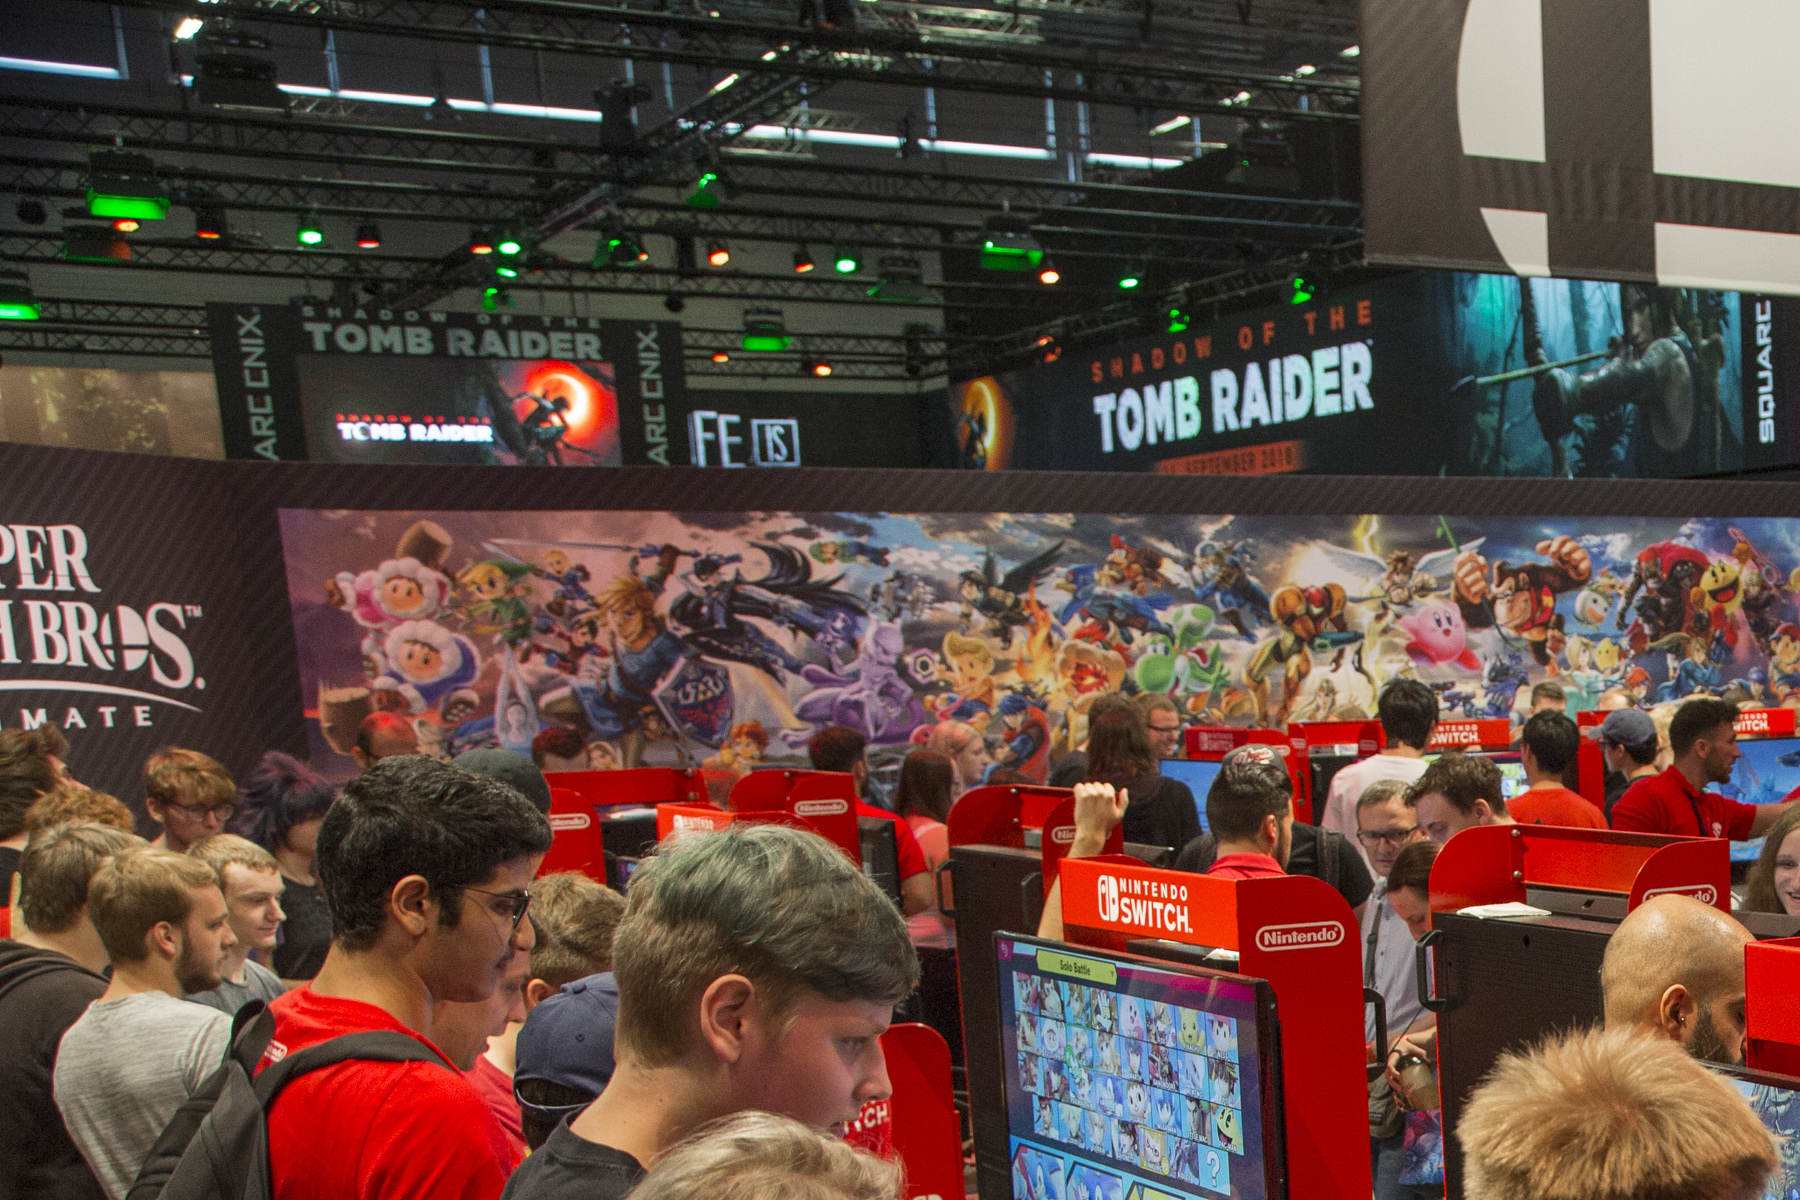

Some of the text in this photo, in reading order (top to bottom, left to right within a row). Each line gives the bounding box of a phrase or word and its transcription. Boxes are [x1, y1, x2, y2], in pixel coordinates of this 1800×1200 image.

[301, 306, 601, 330] SHADOW OF THE
[304, 322, 602, 362] TOMB RAIDER
[1091, 300, 1372, 383] SHADOW OF THE
[1093, 341, 1374, 453] TOMB RAIDER
[337, 422, 494, 442] TOMB RAIDER
[1119, 878, 1188, 902] NINTENDO
[1120, 898, 1190, 934] SWITCH
[1263, 927, 1337, 947] Nintendo
[1060, 959, 1091, 976] Solo Battle
